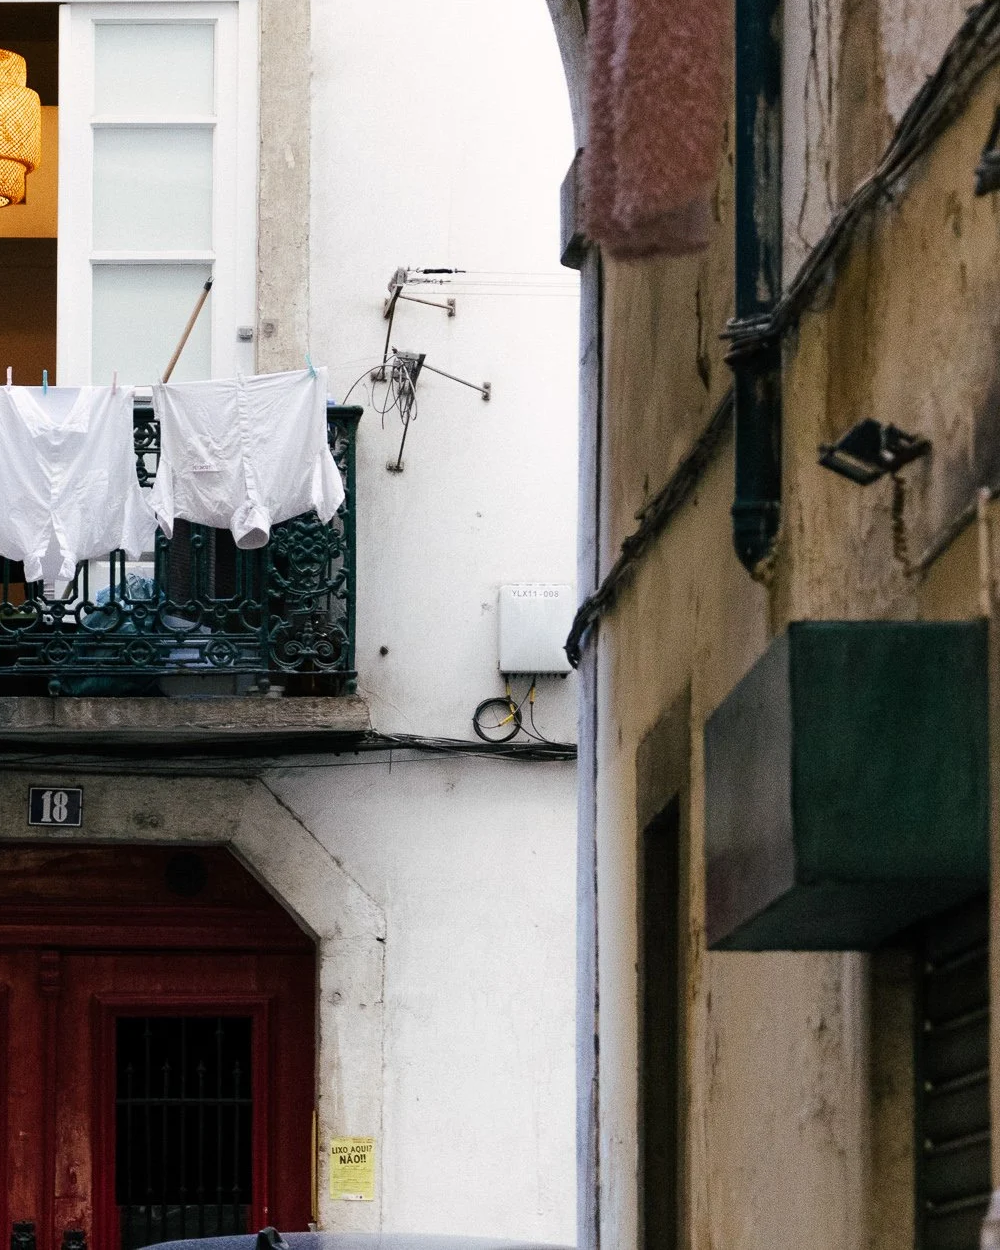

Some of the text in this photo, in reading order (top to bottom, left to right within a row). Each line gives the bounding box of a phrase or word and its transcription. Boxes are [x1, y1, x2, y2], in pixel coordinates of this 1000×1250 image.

[511, 589, 559, 598] YLX11-008
[40, 790, 69, 823] 18
[331, 1144, 373, 1155] LIXO AQUI?
[339, 1153, 367, 1164] NÃO!!
